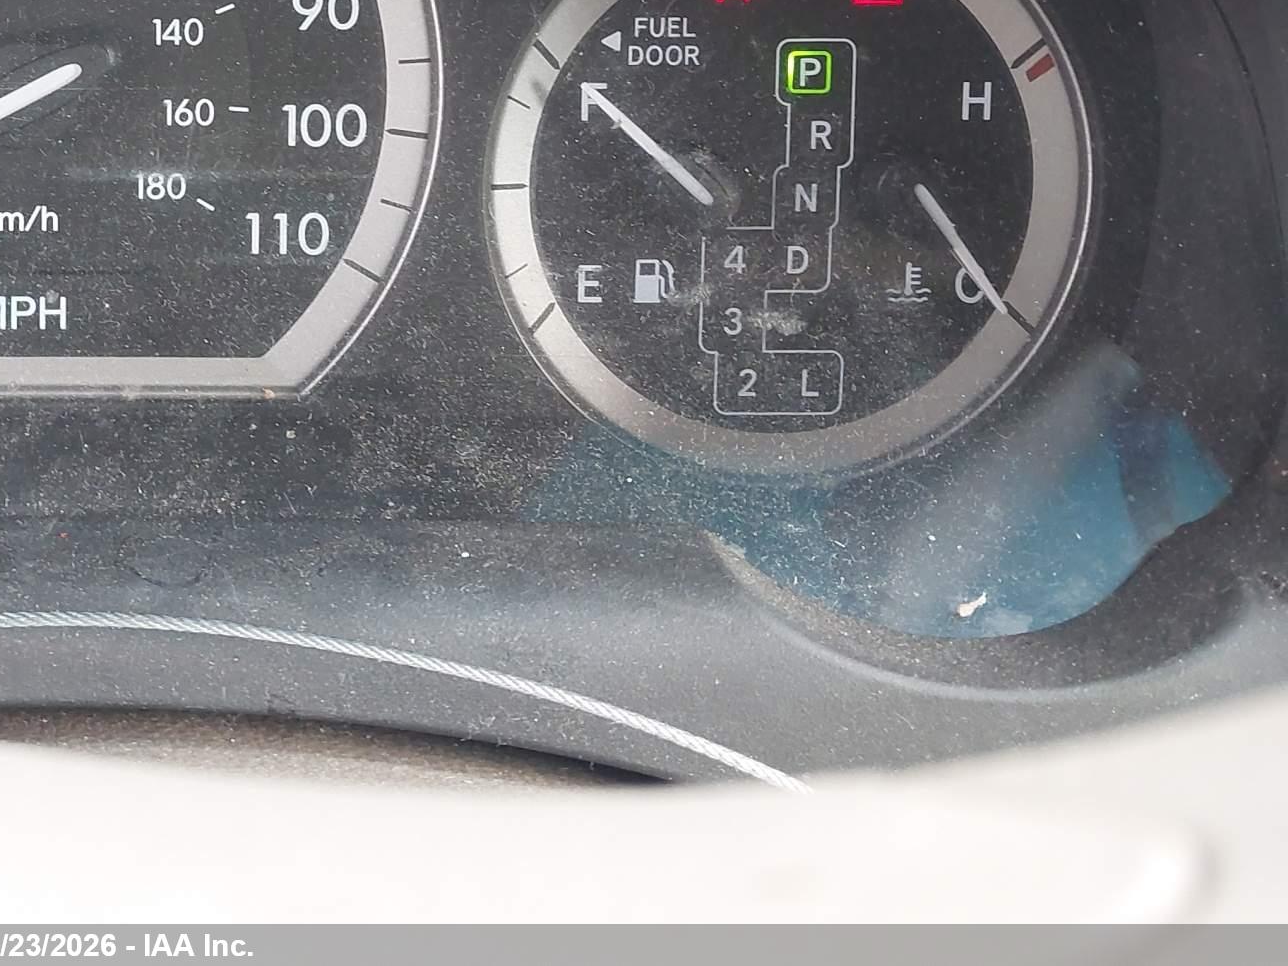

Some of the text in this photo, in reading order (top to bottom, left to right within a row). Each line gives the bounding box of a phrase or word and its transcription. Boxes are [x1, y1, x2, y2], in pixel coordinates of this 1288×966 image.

[153, 18, 204, 48] 140
[633, 17, 696, 39] FUEL
[627, 45, 700, 66] DOOR
[799, 58, 822, 85] P
[163, 98, 215, 128] 160
[961, 81, 992, 122] H
[282, 103, 367, 149] 100
[811, 121, 832, 150] R
[137, 173, 187, 202] 180
[794, 184, 817, 212] N
[245, 212, 329, 257] 110
[723, 245, 746, 273] 4
[787, 246, 809, 274] D
[577, 265, 602, 303] E
[724, 307, 742, 335] 3
[738, 369, 756, 396] 2
[801, 369, 819, 396] L
